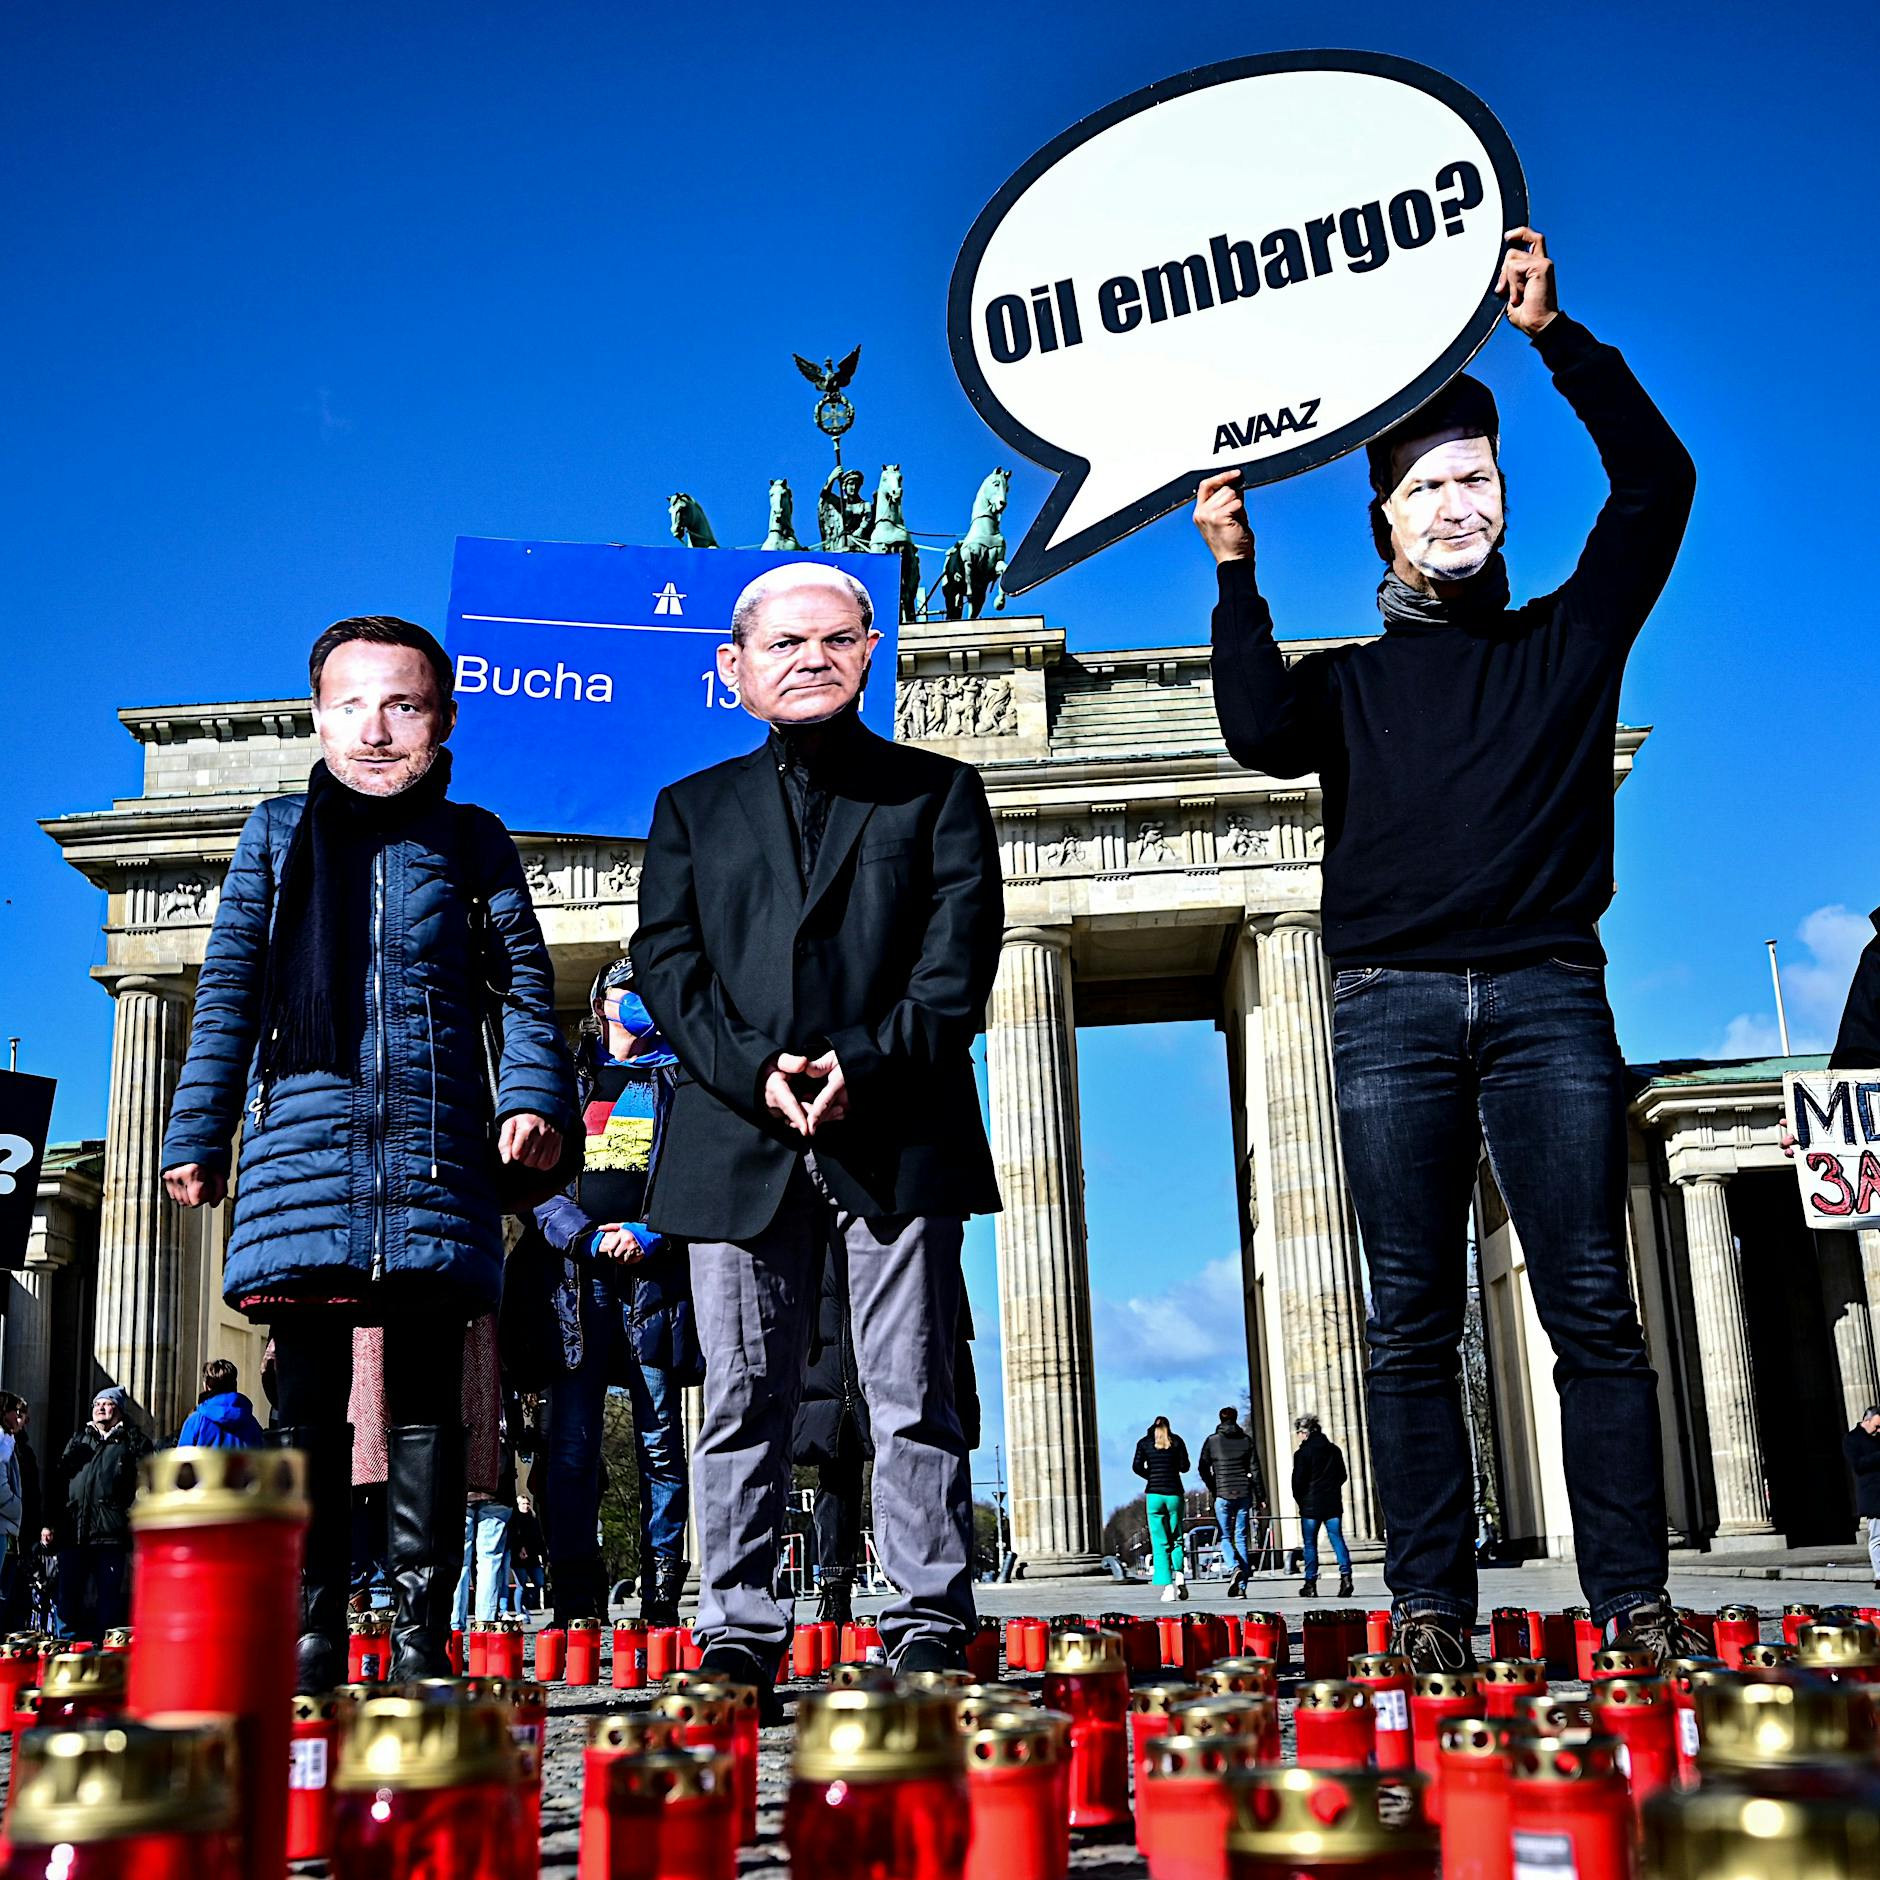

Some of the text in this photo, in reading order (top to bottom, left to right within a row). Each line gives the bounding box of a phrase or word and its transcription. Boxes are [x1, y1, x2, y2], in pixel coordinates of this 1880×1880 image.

[984, 160, 1484, 364] Oil embargo?
[1212, 397, 1321, 456] AVAAZ
[454, 654, 742, 709] Bucha 13
